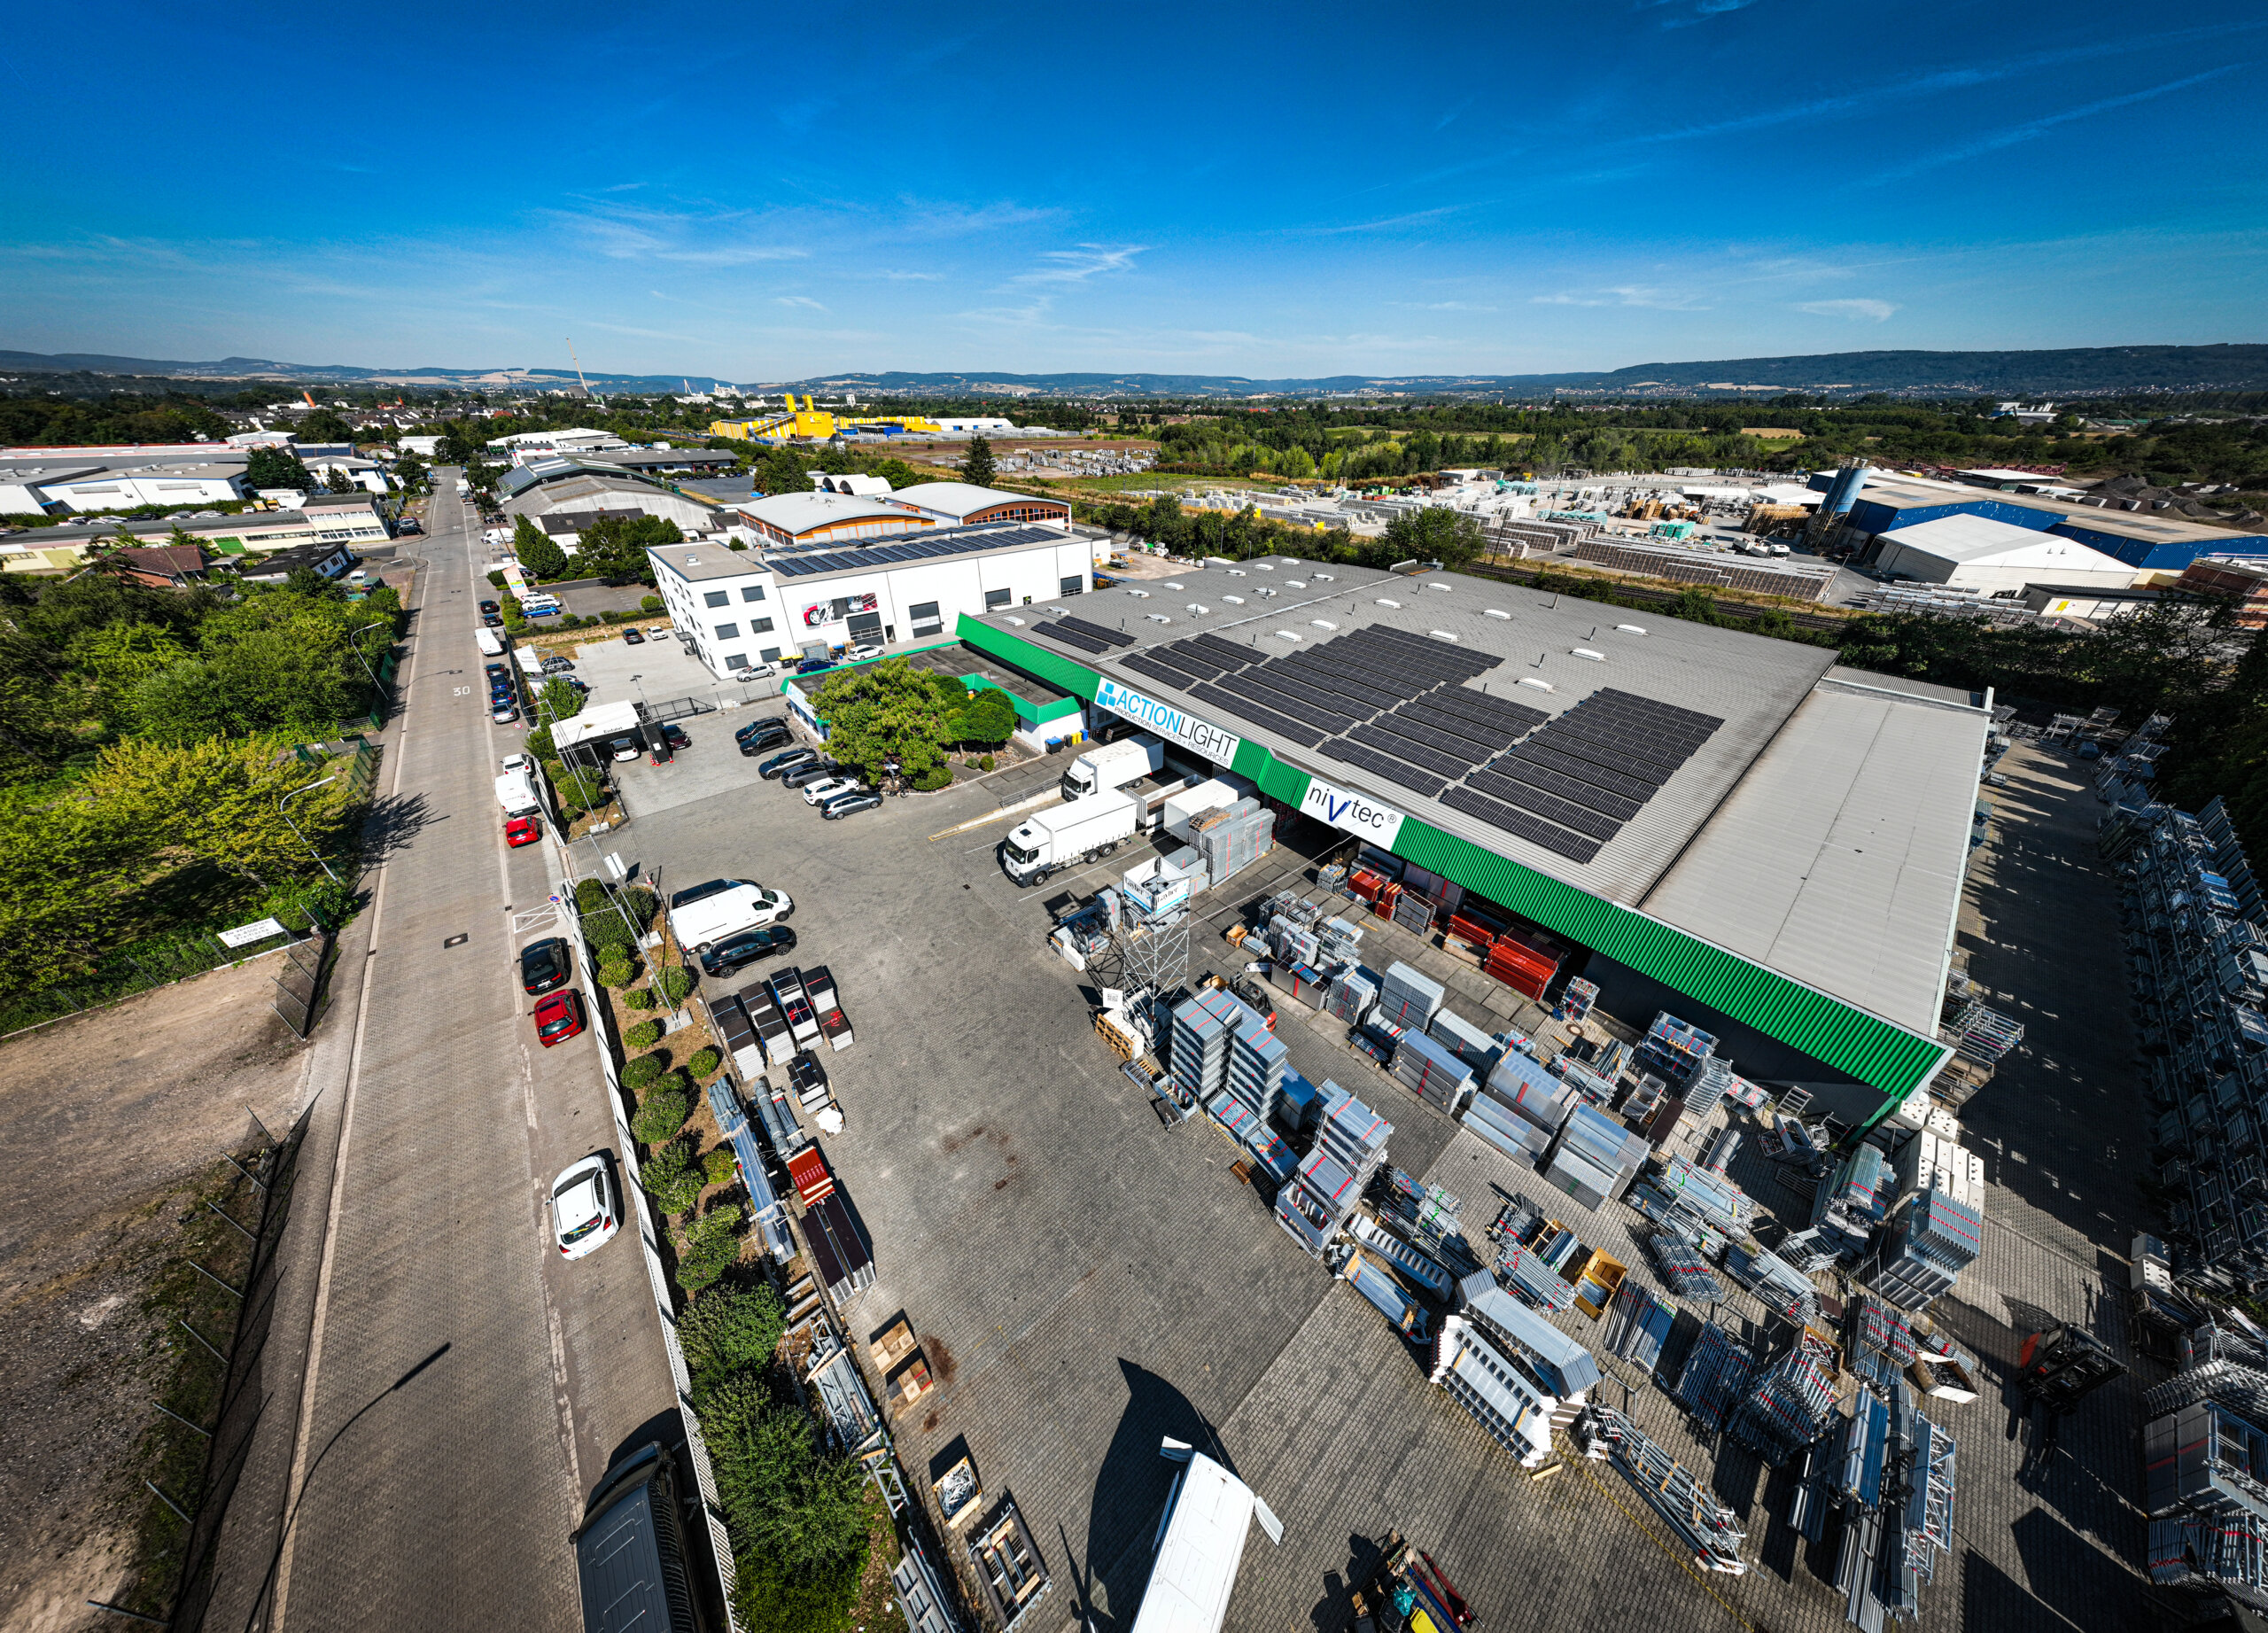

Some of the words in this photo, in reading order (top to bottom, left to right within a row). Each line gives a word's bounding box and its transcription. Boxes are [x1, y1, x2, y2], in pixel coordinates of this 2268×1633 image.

[454, 686, 470, 696] 30
[1115, 707, 1152, 728] PRODUCTION
[1152, 724, 1182, 743] SERVICES
[1188, 742, 1229, 766] RESOURCES
[1124, 876, 1144, 895] Layher
[1157, 887, 1179, 903] Layher
